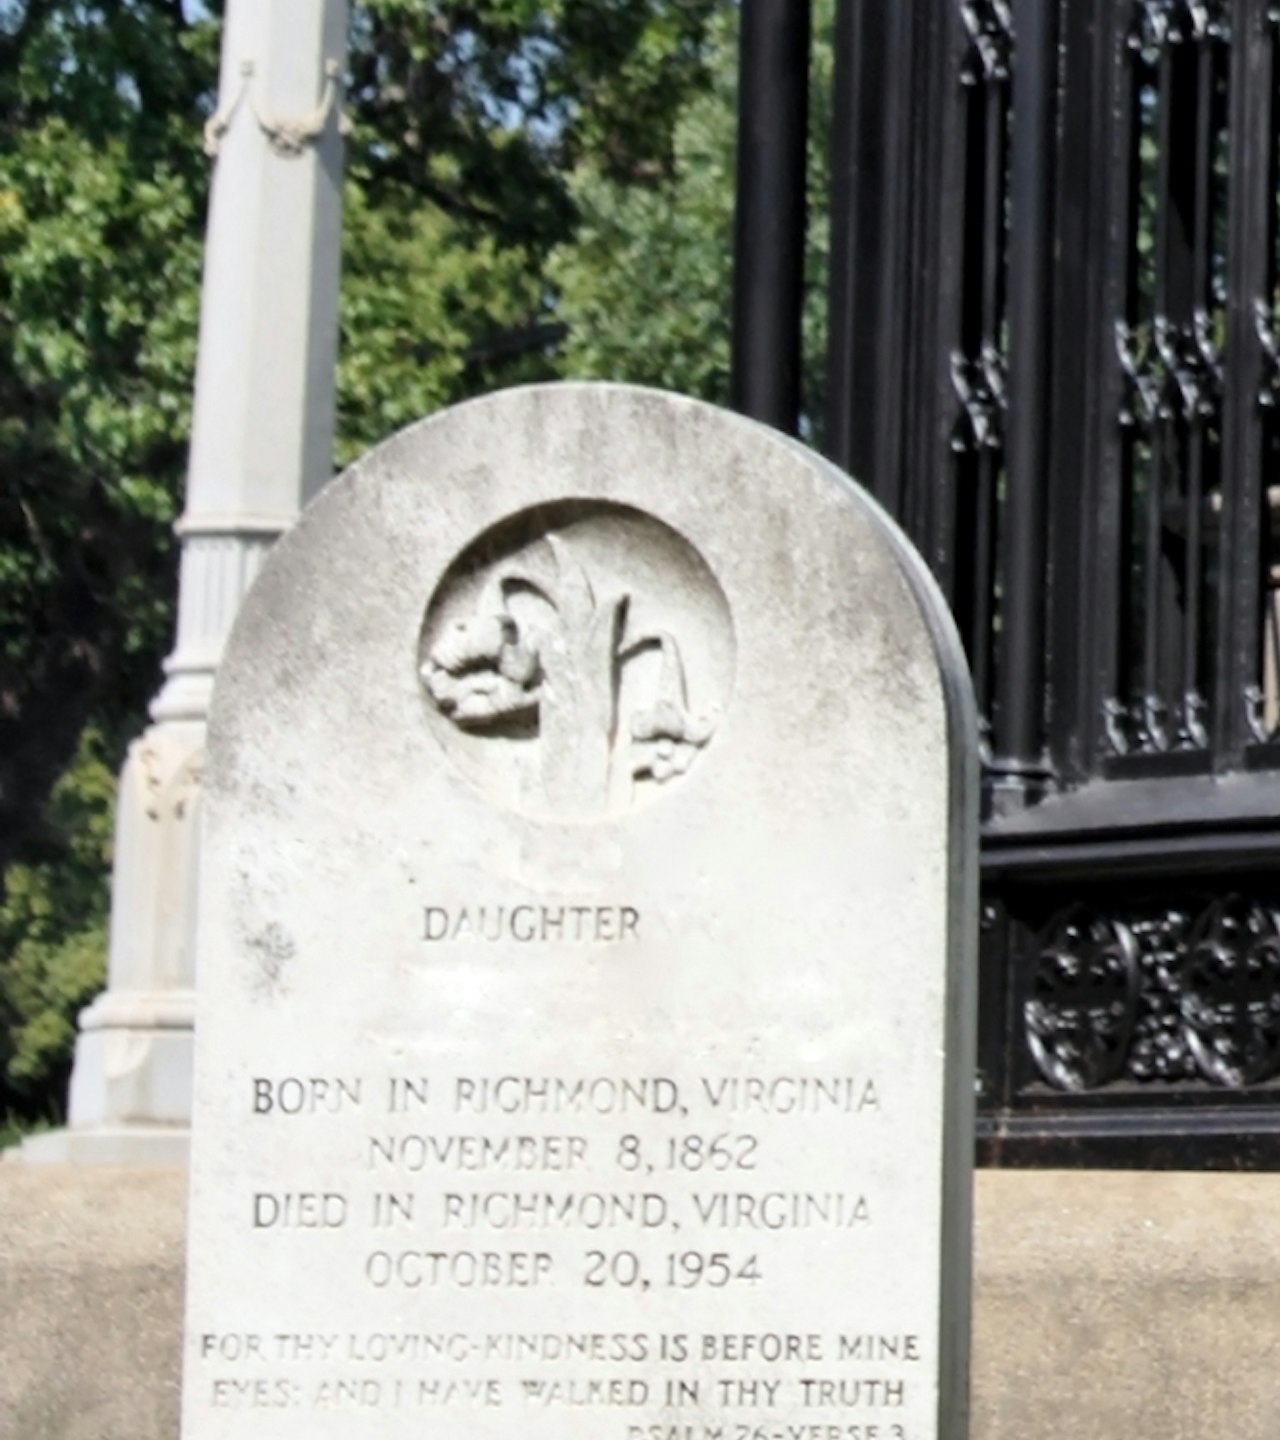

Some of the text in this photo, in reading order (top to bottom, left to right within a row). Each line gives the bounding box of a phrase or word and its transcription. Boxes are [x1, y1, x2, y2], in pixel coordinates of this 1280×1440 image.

[423, 904, 642, 942] DAUGHTER
[253, 1077, 881, 1116] BORN IN RICHMOND, VIRGINIA
[368, 1134, 758, 1173] NOVEMBER 8, 1862
[253, 1193, 872, 1230] DIED IN RICHMOND, VIRGINIA
[366, 1251, 762, 1291] OCTOBER 20, 1954
[201, 1333, 920, 1361] FOR THY LOVING-KINDNESS IS BEFORE MINE
[315, 1379, 382, 1407] AND
[419, 1379, 502, 1407] HAVE
[521, 1379, 649, 1407] WALKED
[665, 1379, 699, 1407] IN
[717, 1379, 781, 1407] THY
[800, 1379, 904, 1407] TRUTH
